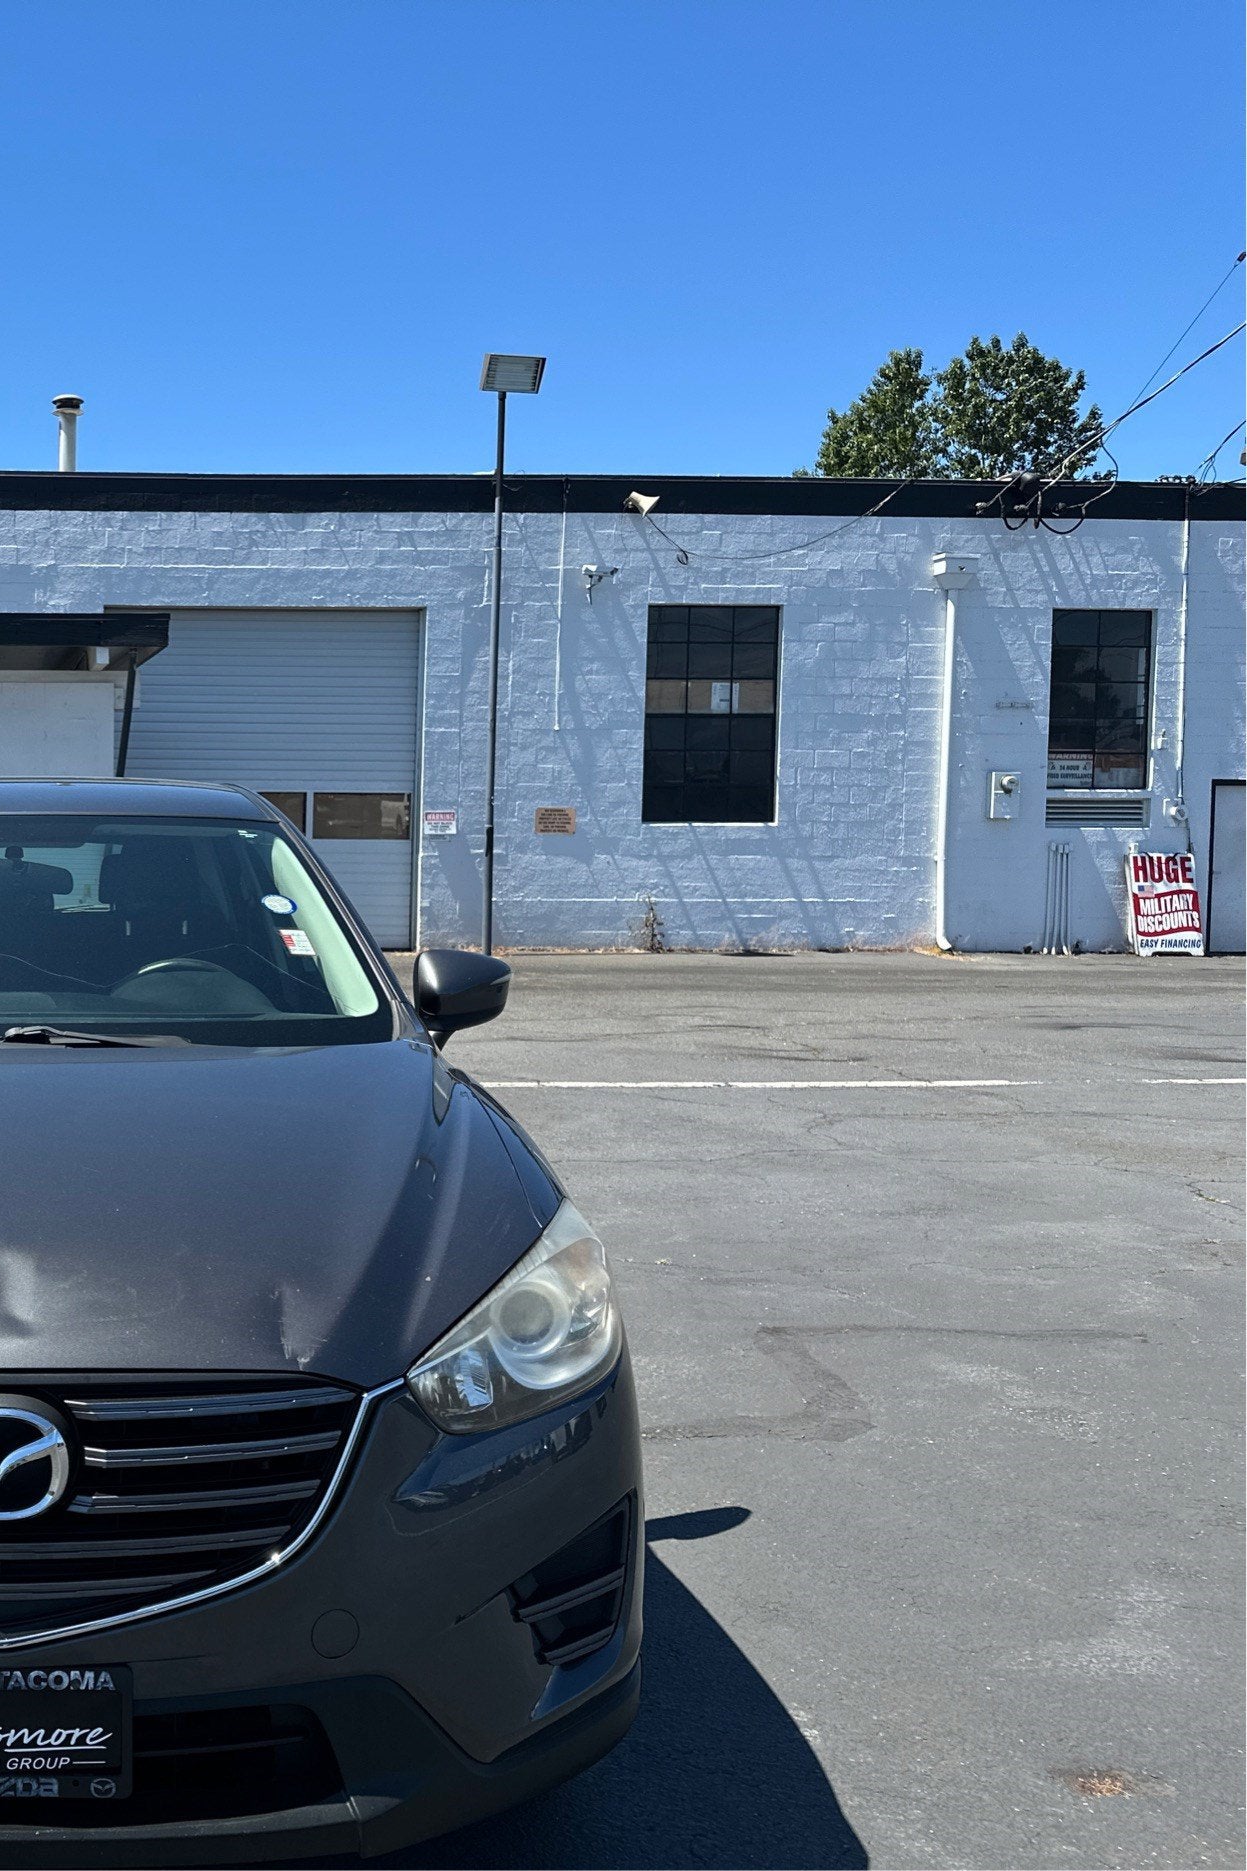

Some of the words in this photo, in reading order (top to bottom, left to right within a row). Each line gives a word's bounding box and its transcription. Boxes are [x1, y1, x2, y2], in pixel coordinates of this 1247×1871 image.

[427, 813, 454, 821] WARNING
[1132, 855, 1194, 884] HUGE
[1139, 893, 1194, 915] MILITARY
[1136, 911, 1200, 933] DISCOUNTS
[1140, 939, 1159, 949] EASY
[1160, 939, 1202, 949] FINANCING
[6, 1757, 71, 1770] GROUP
